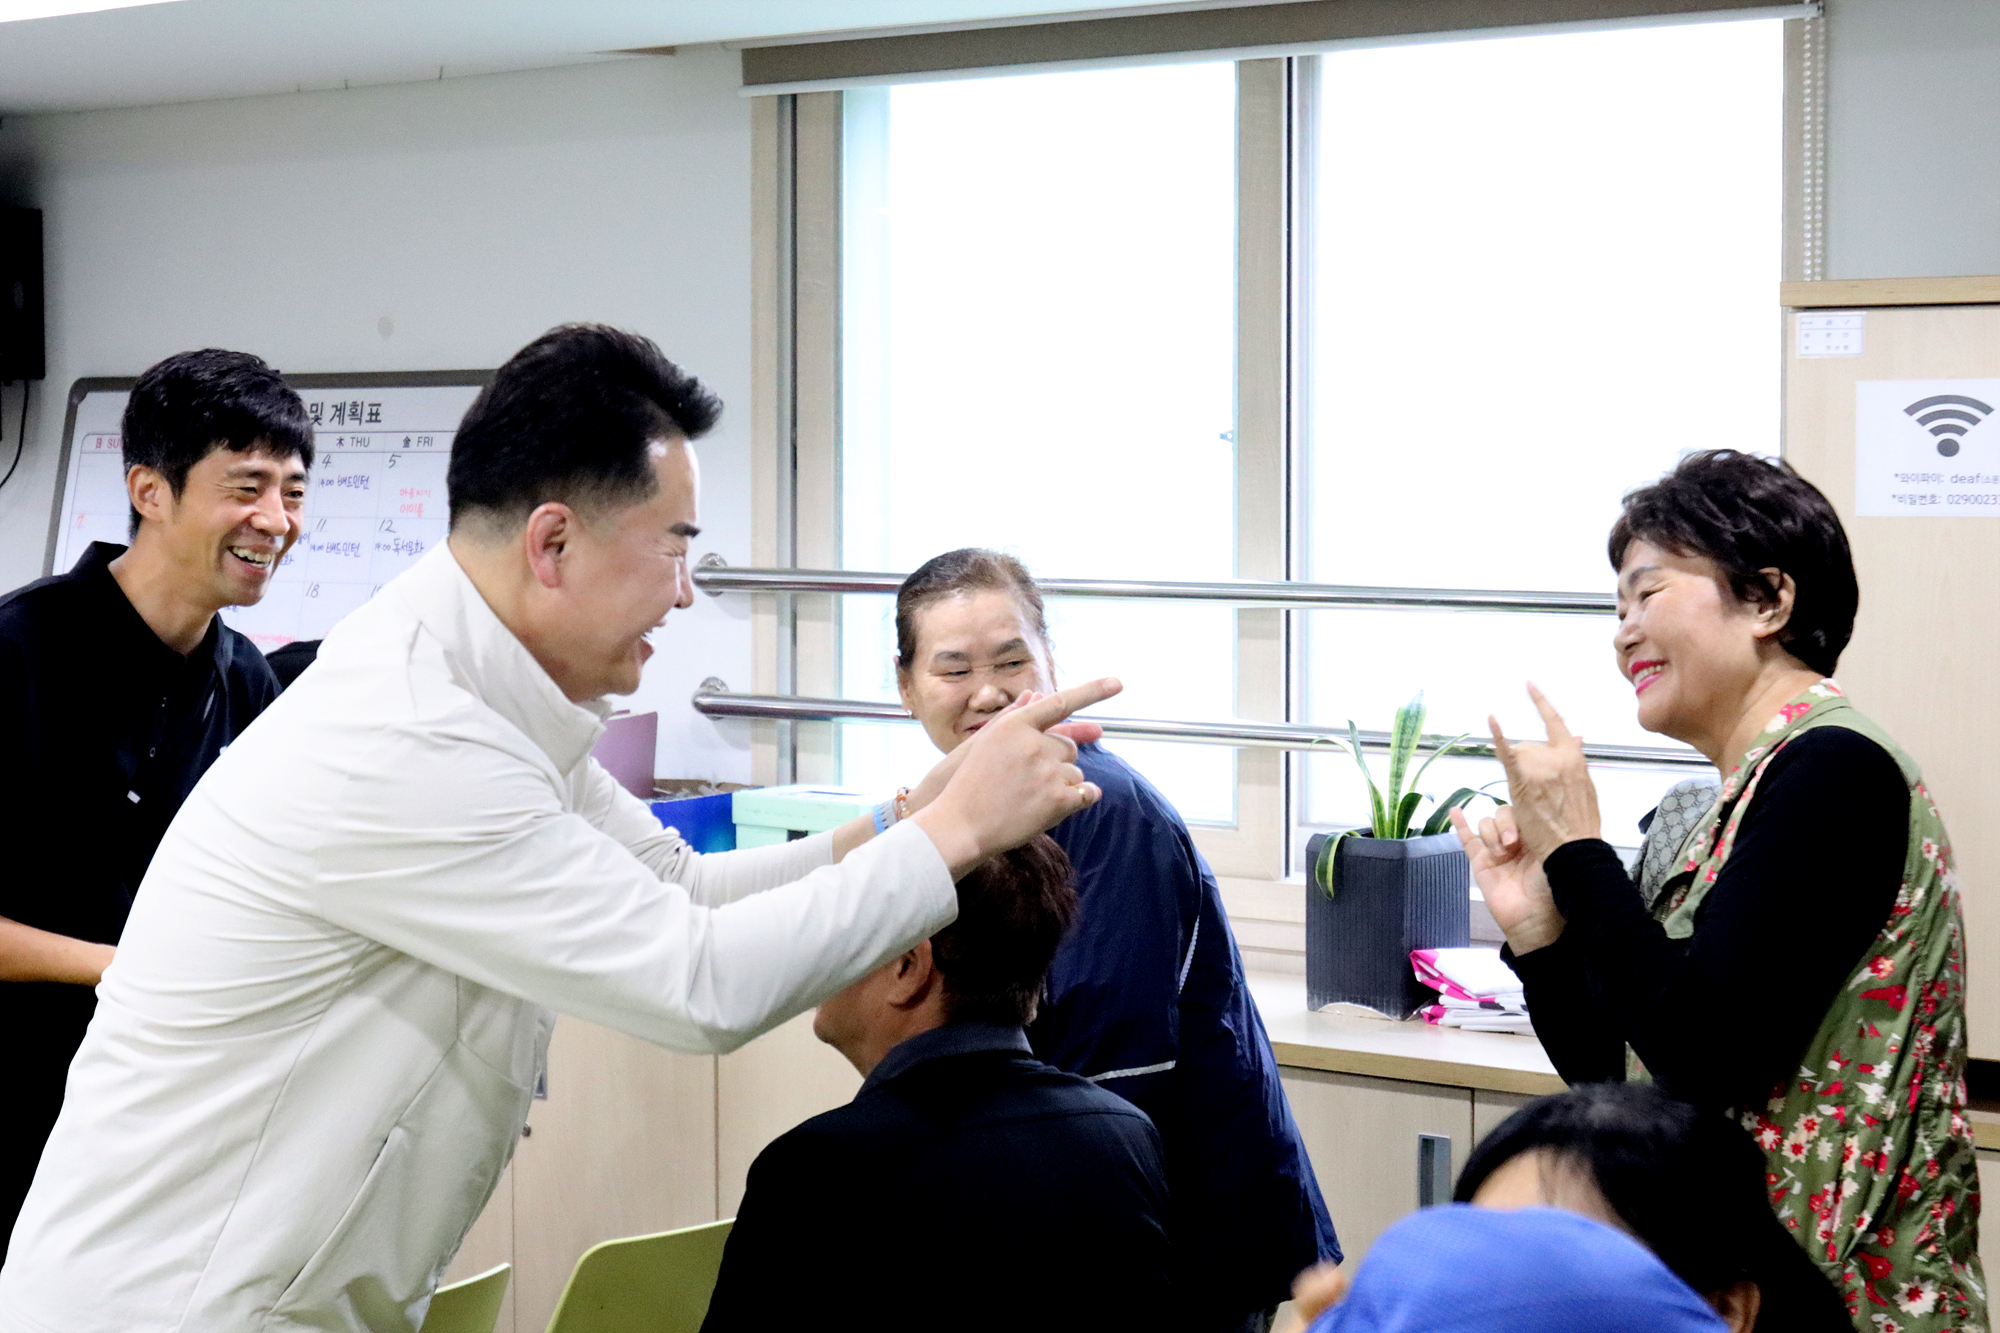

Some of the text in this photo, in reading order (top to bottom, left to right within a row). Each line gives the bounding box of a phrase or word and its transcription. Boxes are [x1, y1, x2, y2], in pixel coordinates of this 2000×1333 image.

[309, 401, 382, 426] 및 계획표
[336, 436, 370, 448] 木 THU
[402, 435, 434, 448] 金 FRI
[322, 453, 332, 469] 4
[388, 453, 402, 469] 5
[338, 475, 370, 490] 배드민턴
[378, 519, 397, 533] 12
[325, 541, 361, 557] 배드민턴
[305, 582, 320, 598] 18
